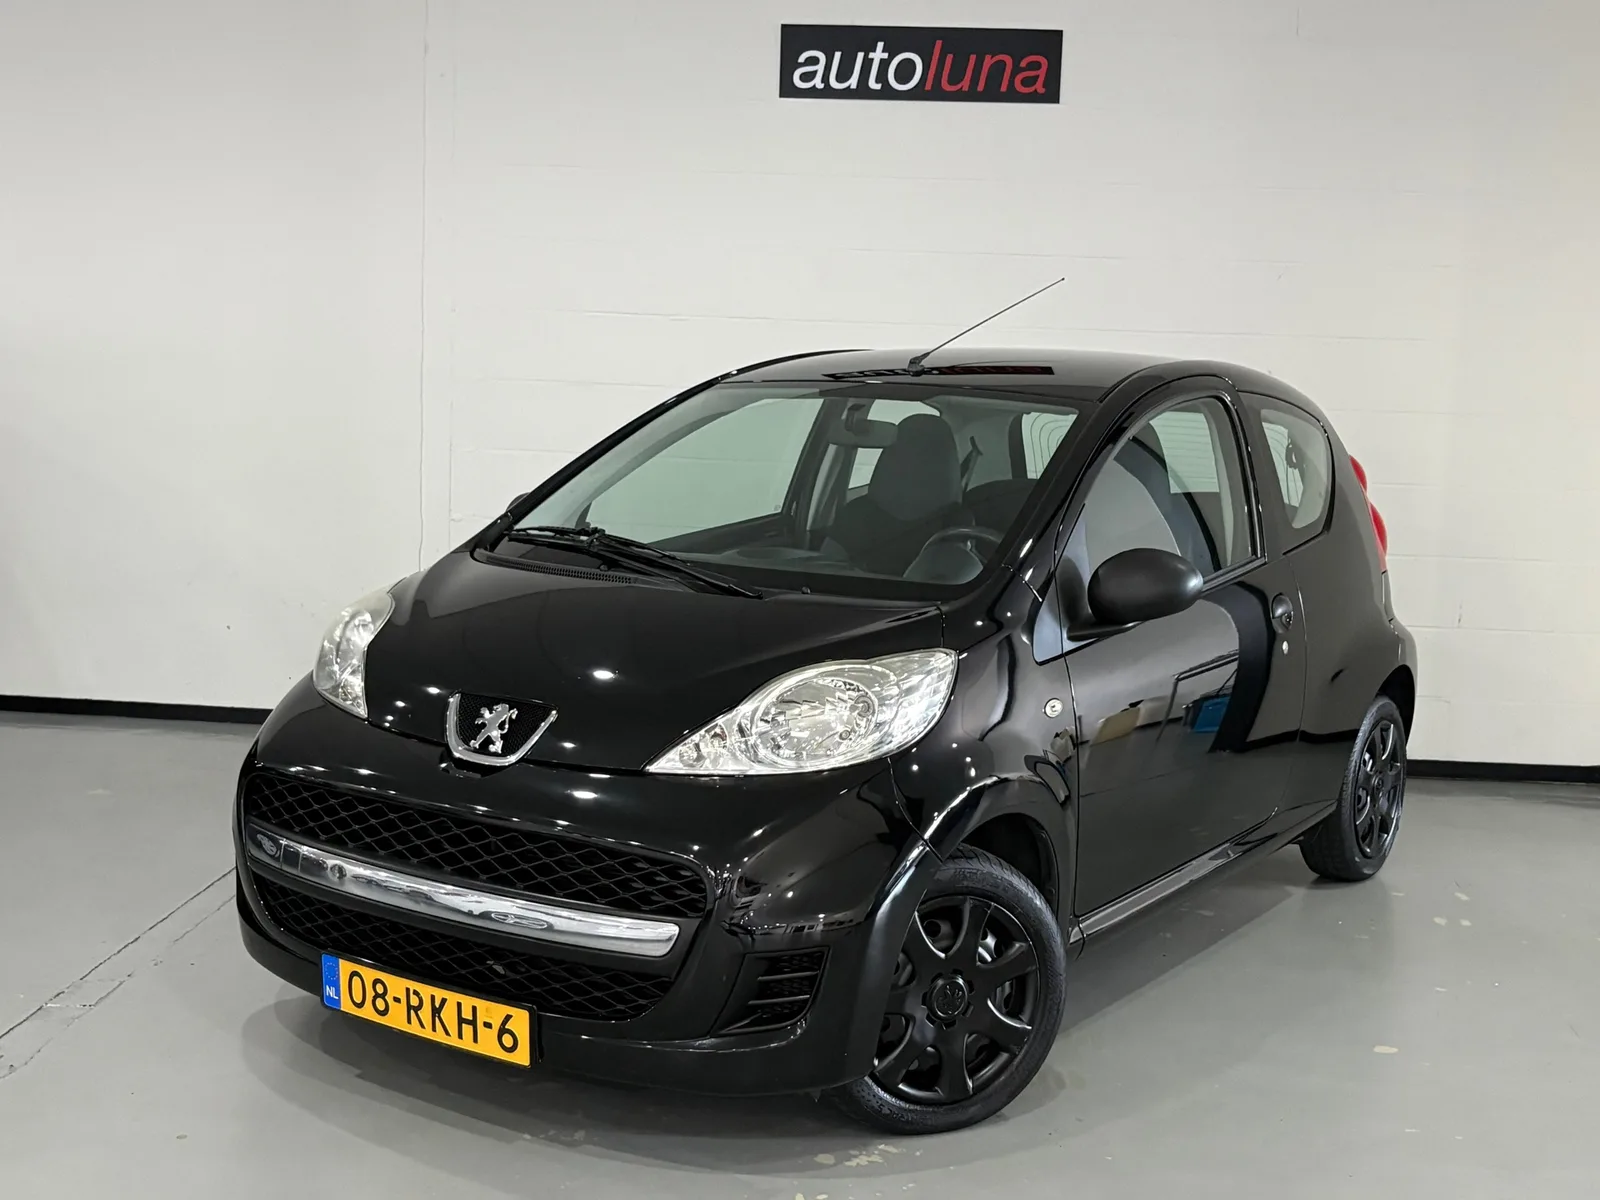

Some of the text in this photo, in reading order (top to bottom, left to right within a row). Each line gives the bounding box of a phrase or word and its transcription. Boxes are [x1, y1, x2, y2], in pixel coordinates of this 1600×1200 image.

[792, 40, 1049, 94] autoluna
[326, 984, 339, 1000] NL
[347, 970, 519, 1054] 08-RKH-6
